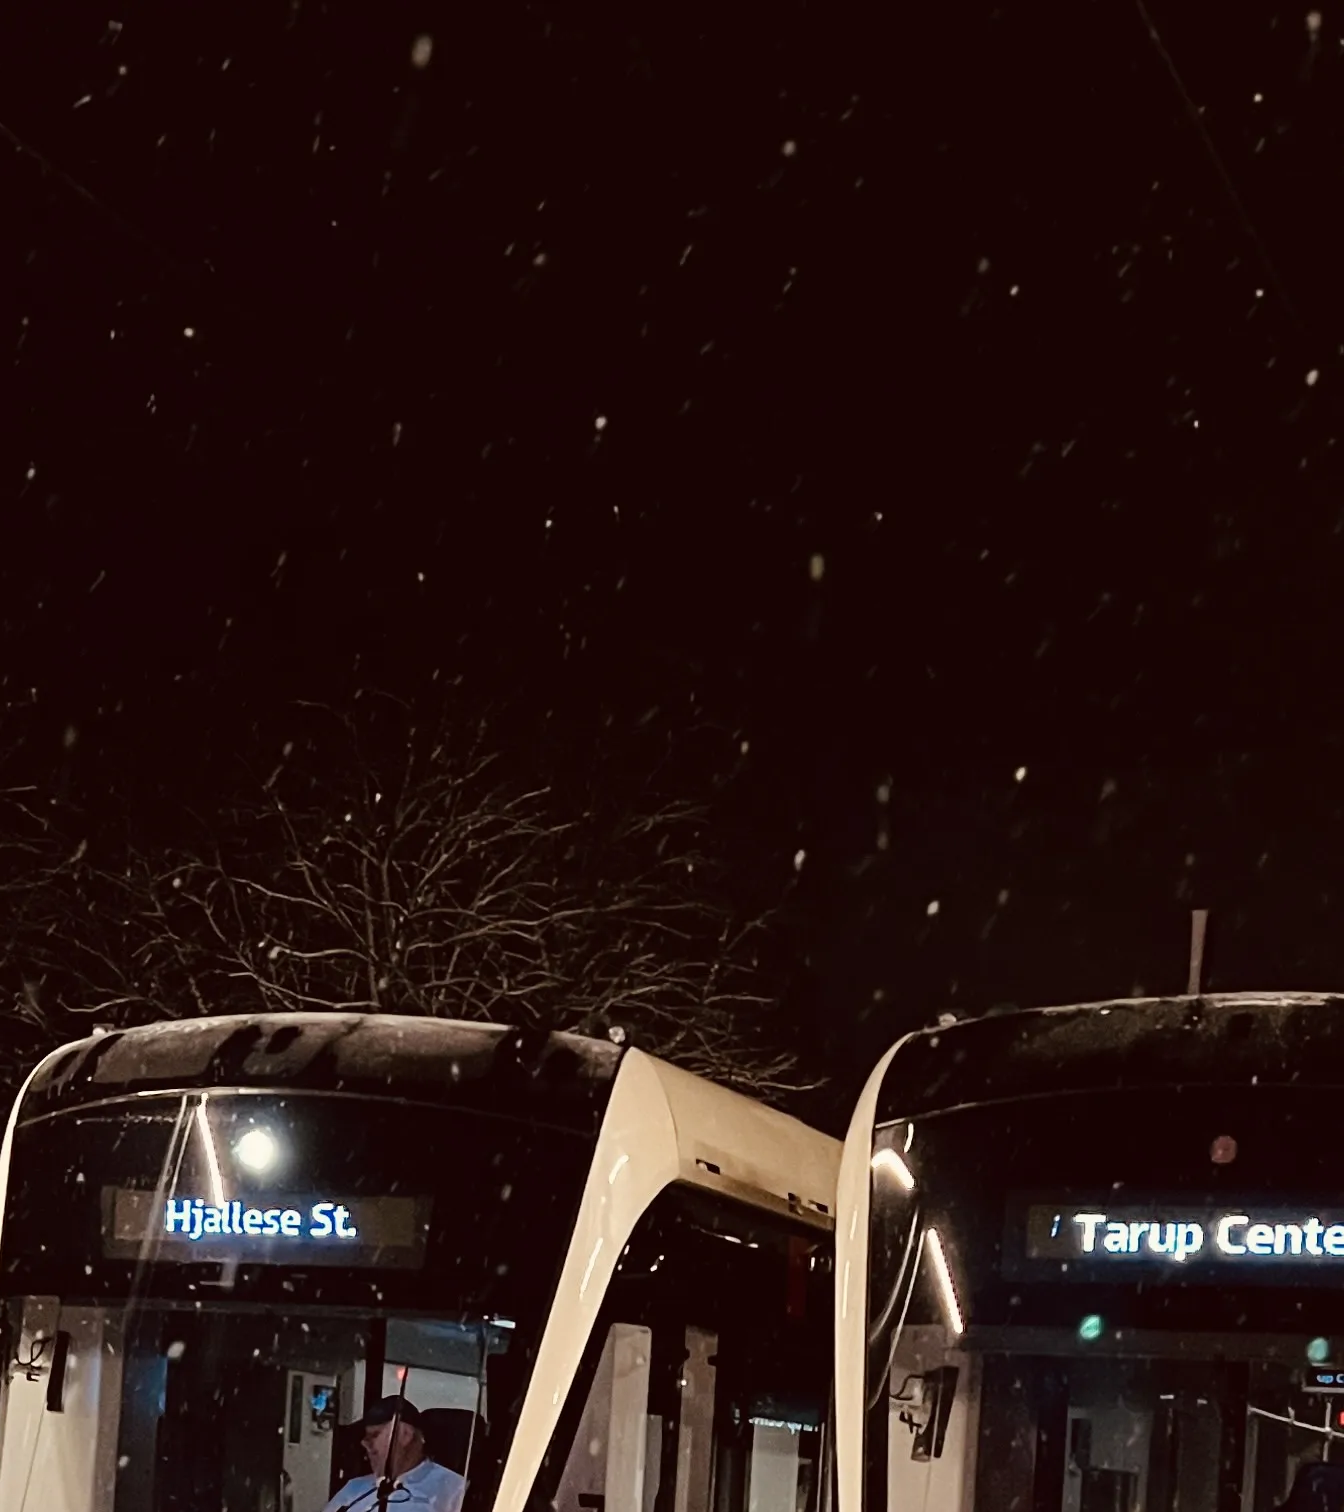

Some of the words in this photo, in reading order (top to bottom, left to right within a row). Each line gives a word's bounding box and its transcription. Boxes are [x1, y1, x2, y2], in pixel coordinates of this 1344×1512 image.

[165, 1198, 302, 1240] Hjallese
[309, 1202, 358, 1239] St.
[1072, 1212, 1205, 1262] Tarup
